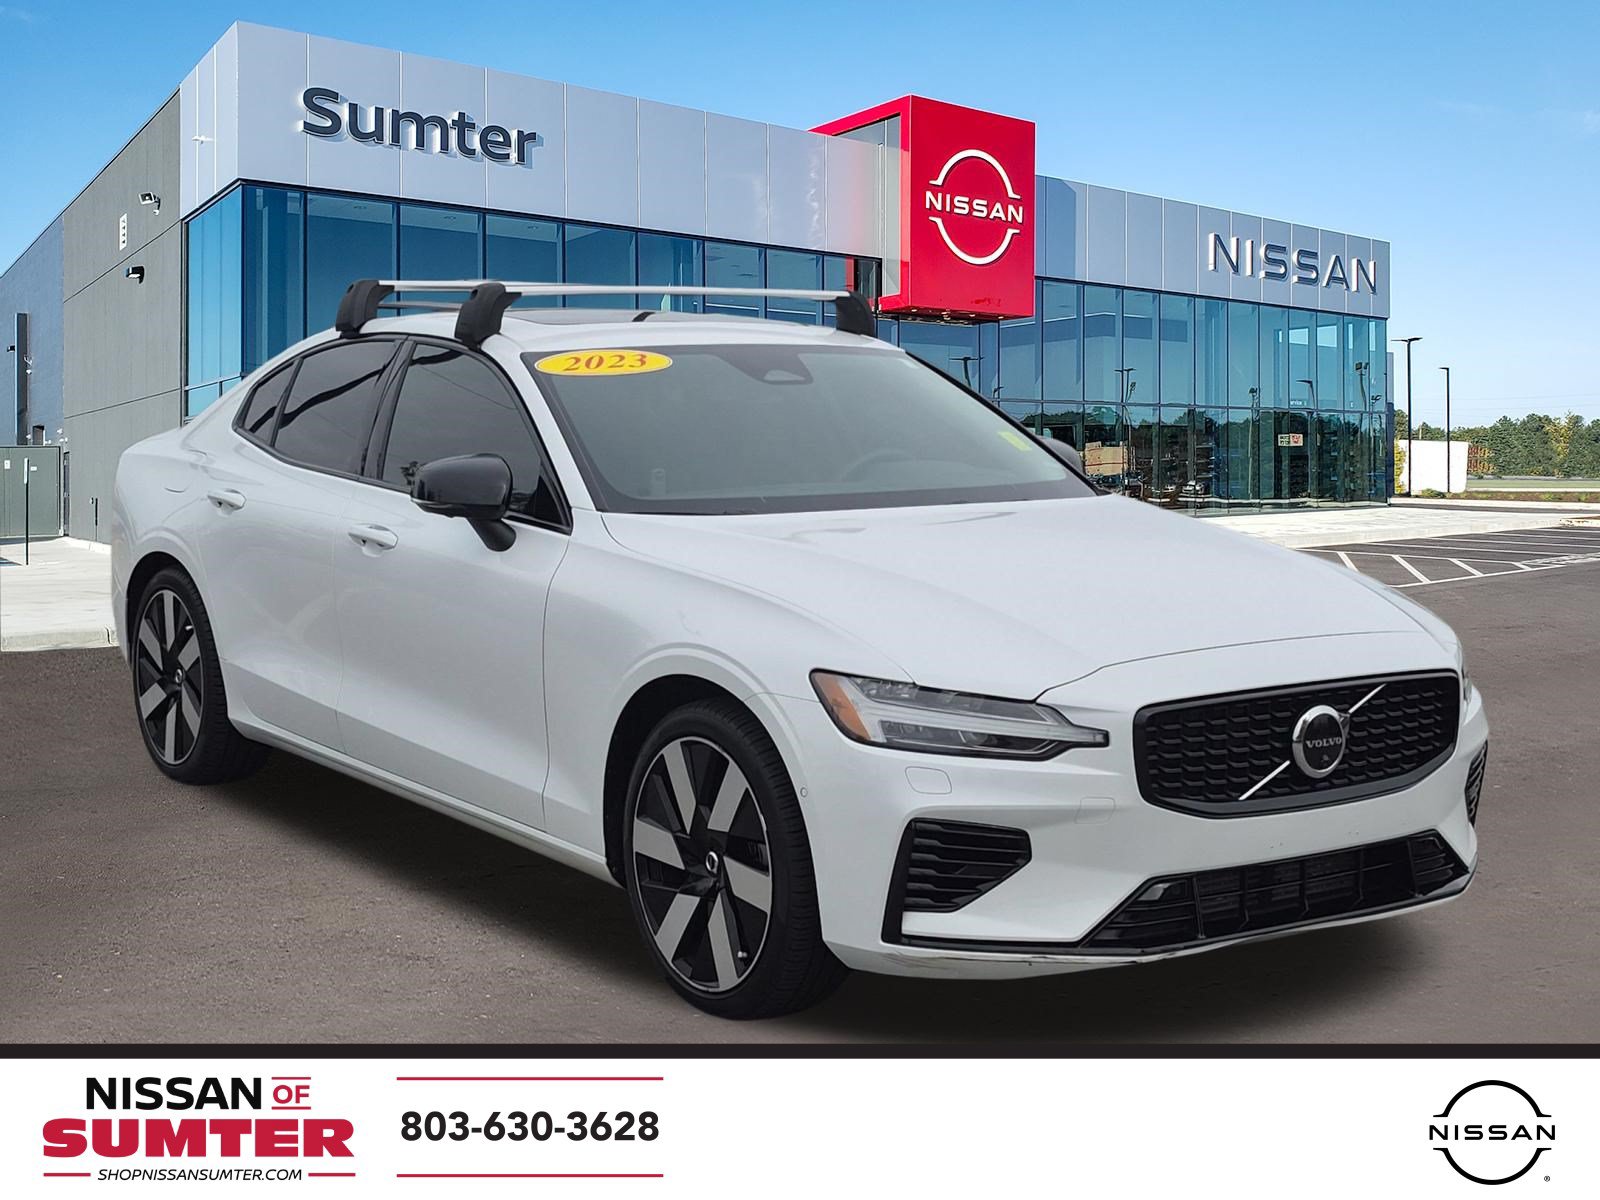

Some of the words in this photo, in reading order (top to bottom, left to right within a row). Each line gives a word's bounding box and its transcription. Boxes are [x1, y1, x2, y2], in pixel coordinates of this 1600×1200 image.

[301, 87, 537, 166] Sumter
[925, 189, 1024, 225] NISSAN
[1208, 231, 1377, 295] NISSAN
[564, 351, 647, 371] 2023
[1305, 737, 1342, 748] VOLVO
